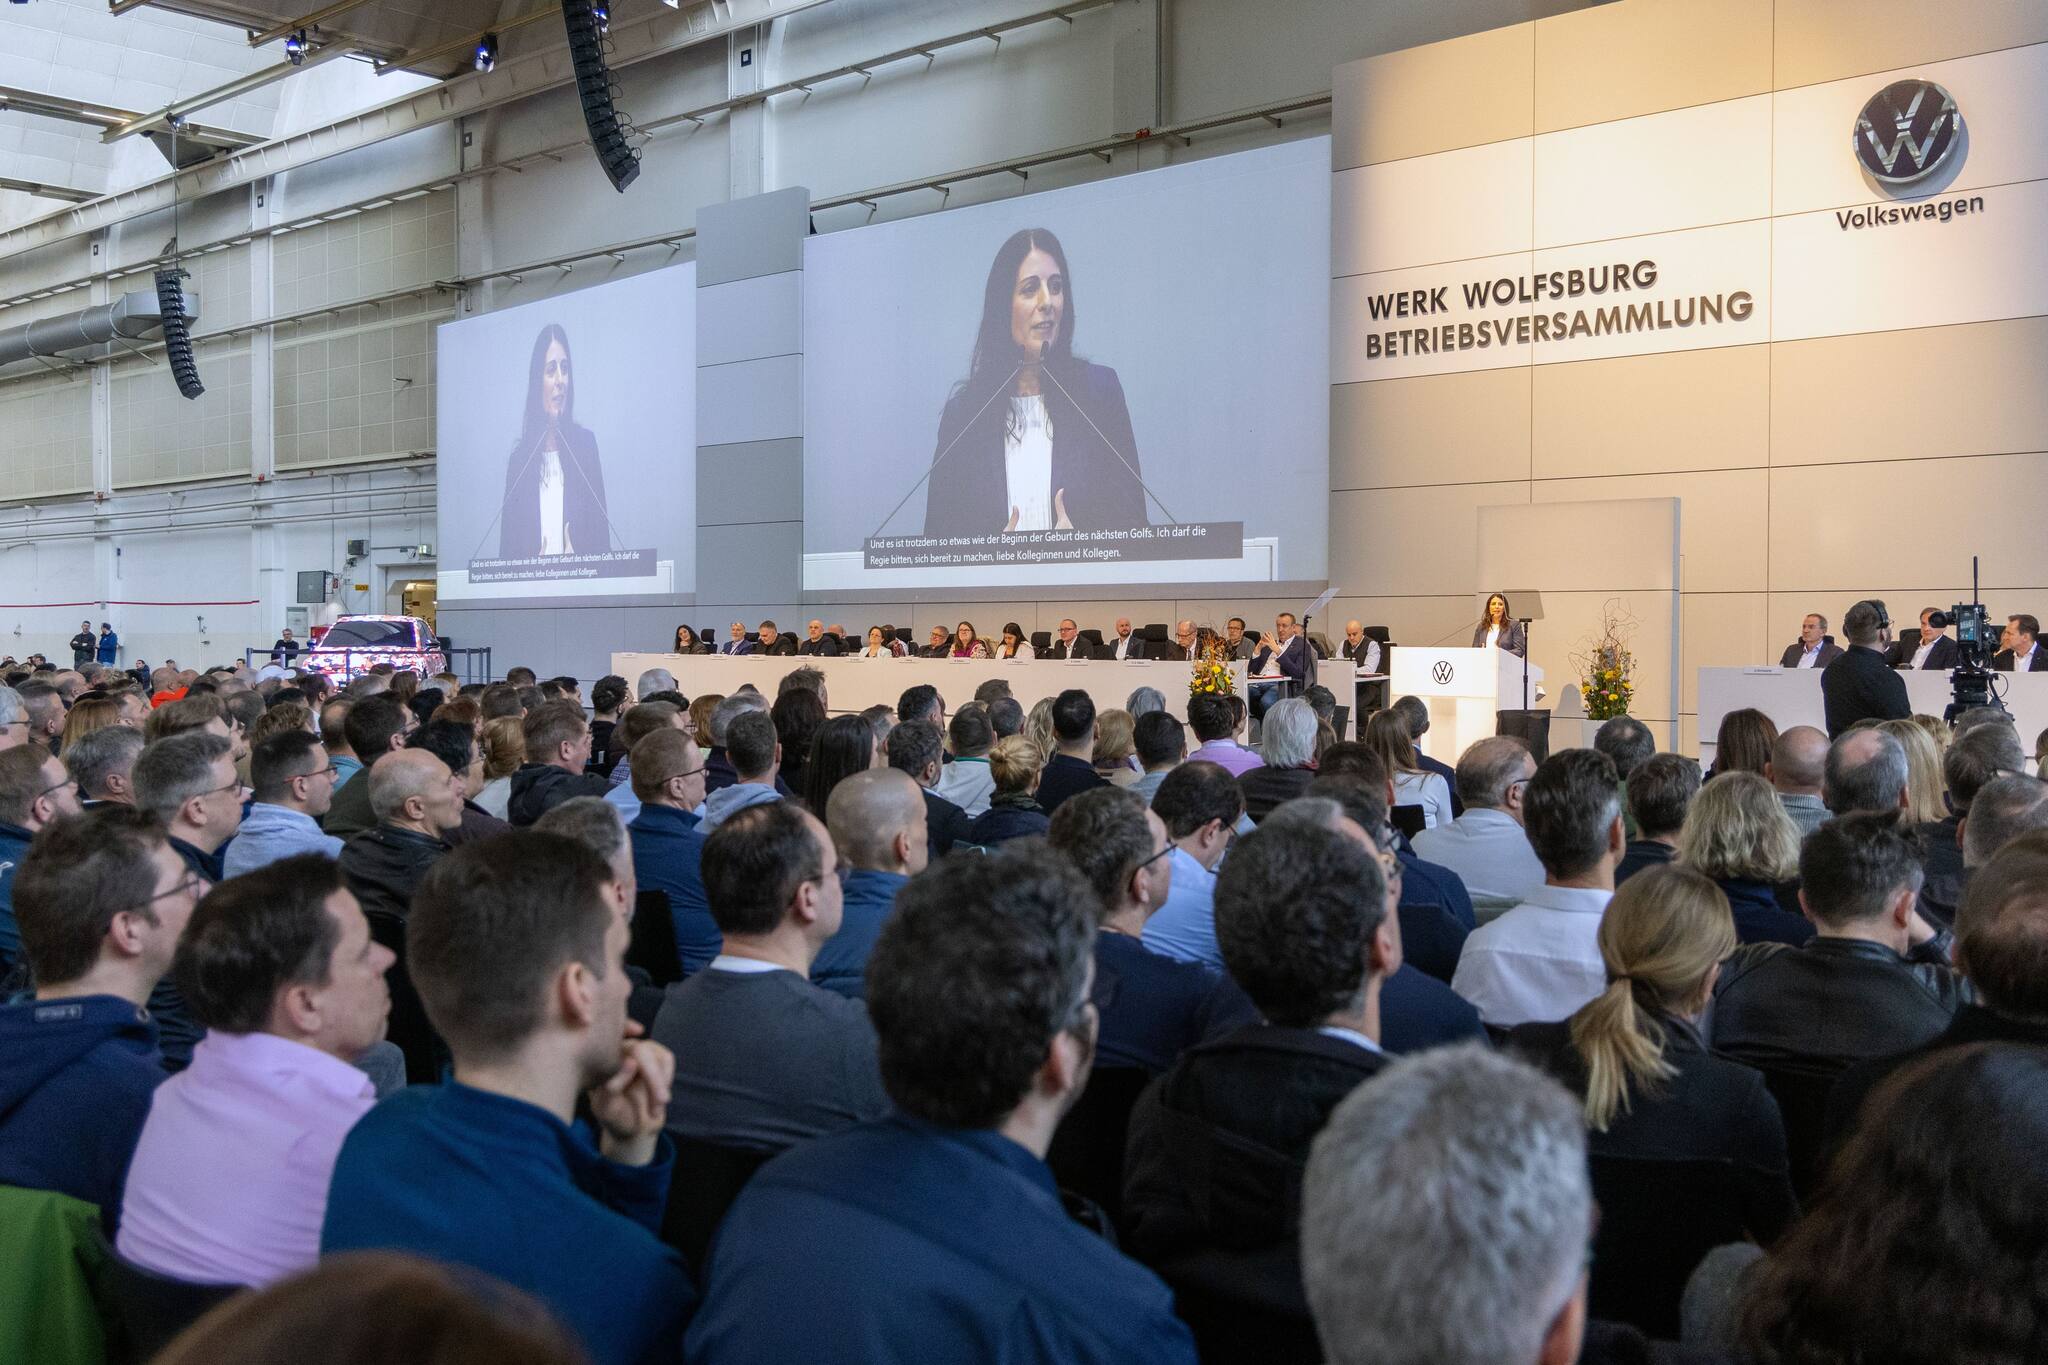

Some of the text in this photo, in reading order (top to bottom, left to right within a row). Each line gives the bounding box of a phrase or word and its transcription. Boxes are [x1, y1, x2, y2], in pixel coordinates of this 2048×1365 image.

[1836, 196, 1984, 230] Volkswagen
[1367, 260, 1657, 321] WERK WOLFSBURG
[1366, 290, 1753, 360] BETRIEBSVERSAMMLUNG
[870, 525, 1206, 549] Und es ist trotzdem so etwas wie der Beginn der Geburt des nächsten Golfs. Ich darf die
[870, 556, 890, 567] Regie
[891, 555, 914, 565] bitten,
[915, 554, 928, 563] sich
[930, 553, 950, 563] bereit
[963, 552, 994, 563] machen,
[996, 551, 1015, 561] liebe
[1016, 550, 1063, 562] Kolleginnen
[1065, 549, 1080, 559] und
[1082, 548, 1122, 560] Kollegen.
